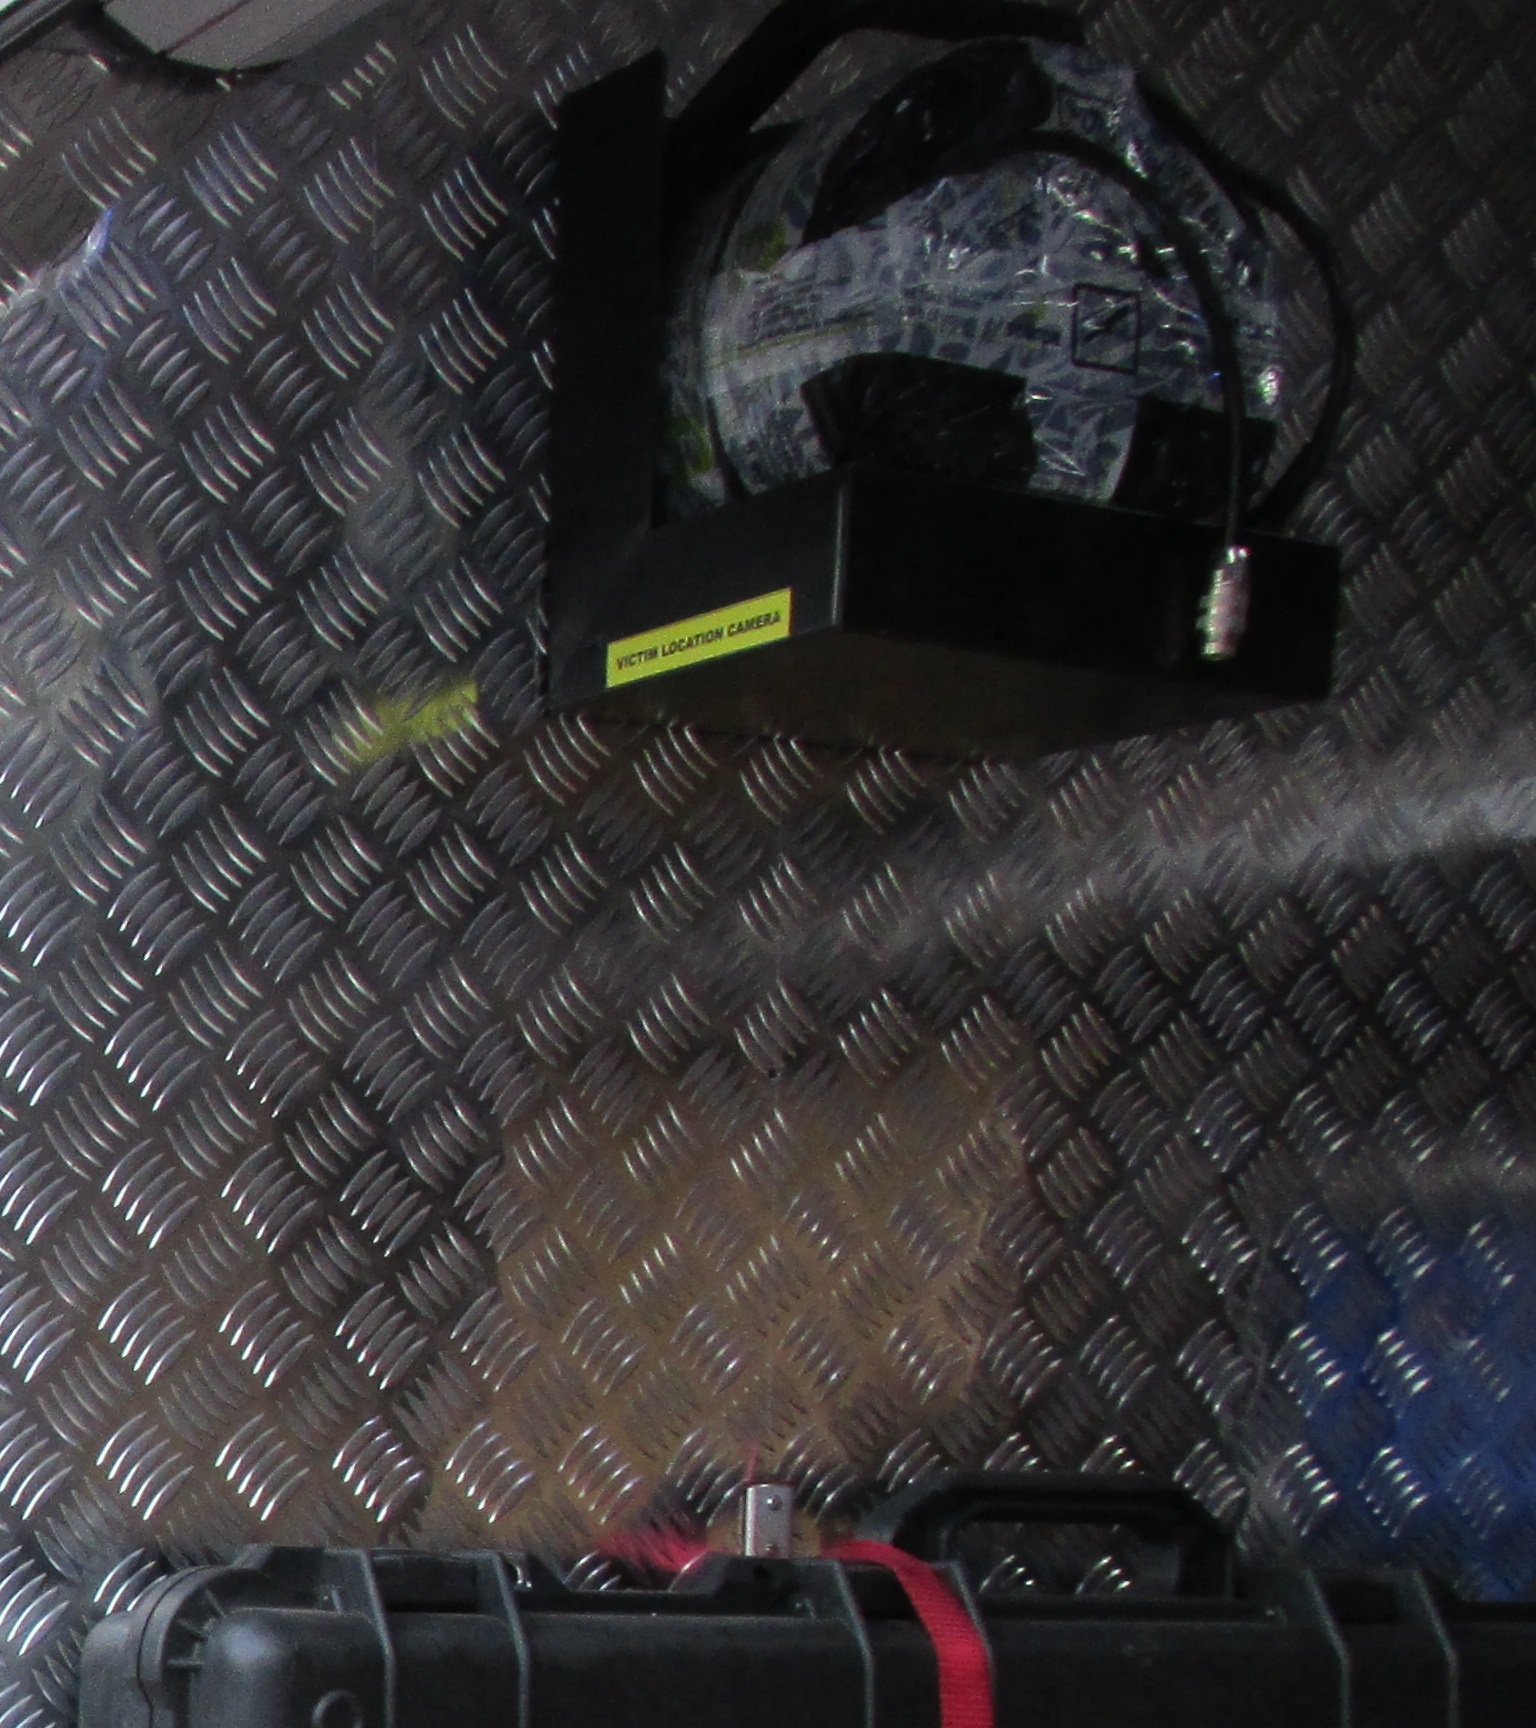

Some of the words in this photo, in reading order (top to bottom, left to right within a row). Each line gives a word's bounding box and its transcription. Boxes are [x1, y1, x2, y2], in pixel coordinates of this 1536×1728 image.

[617, 648, 659, 670] VICTIM
[661, 627, 725, 657] LOCATION
[727, 610, 781, 637] CAMERA
